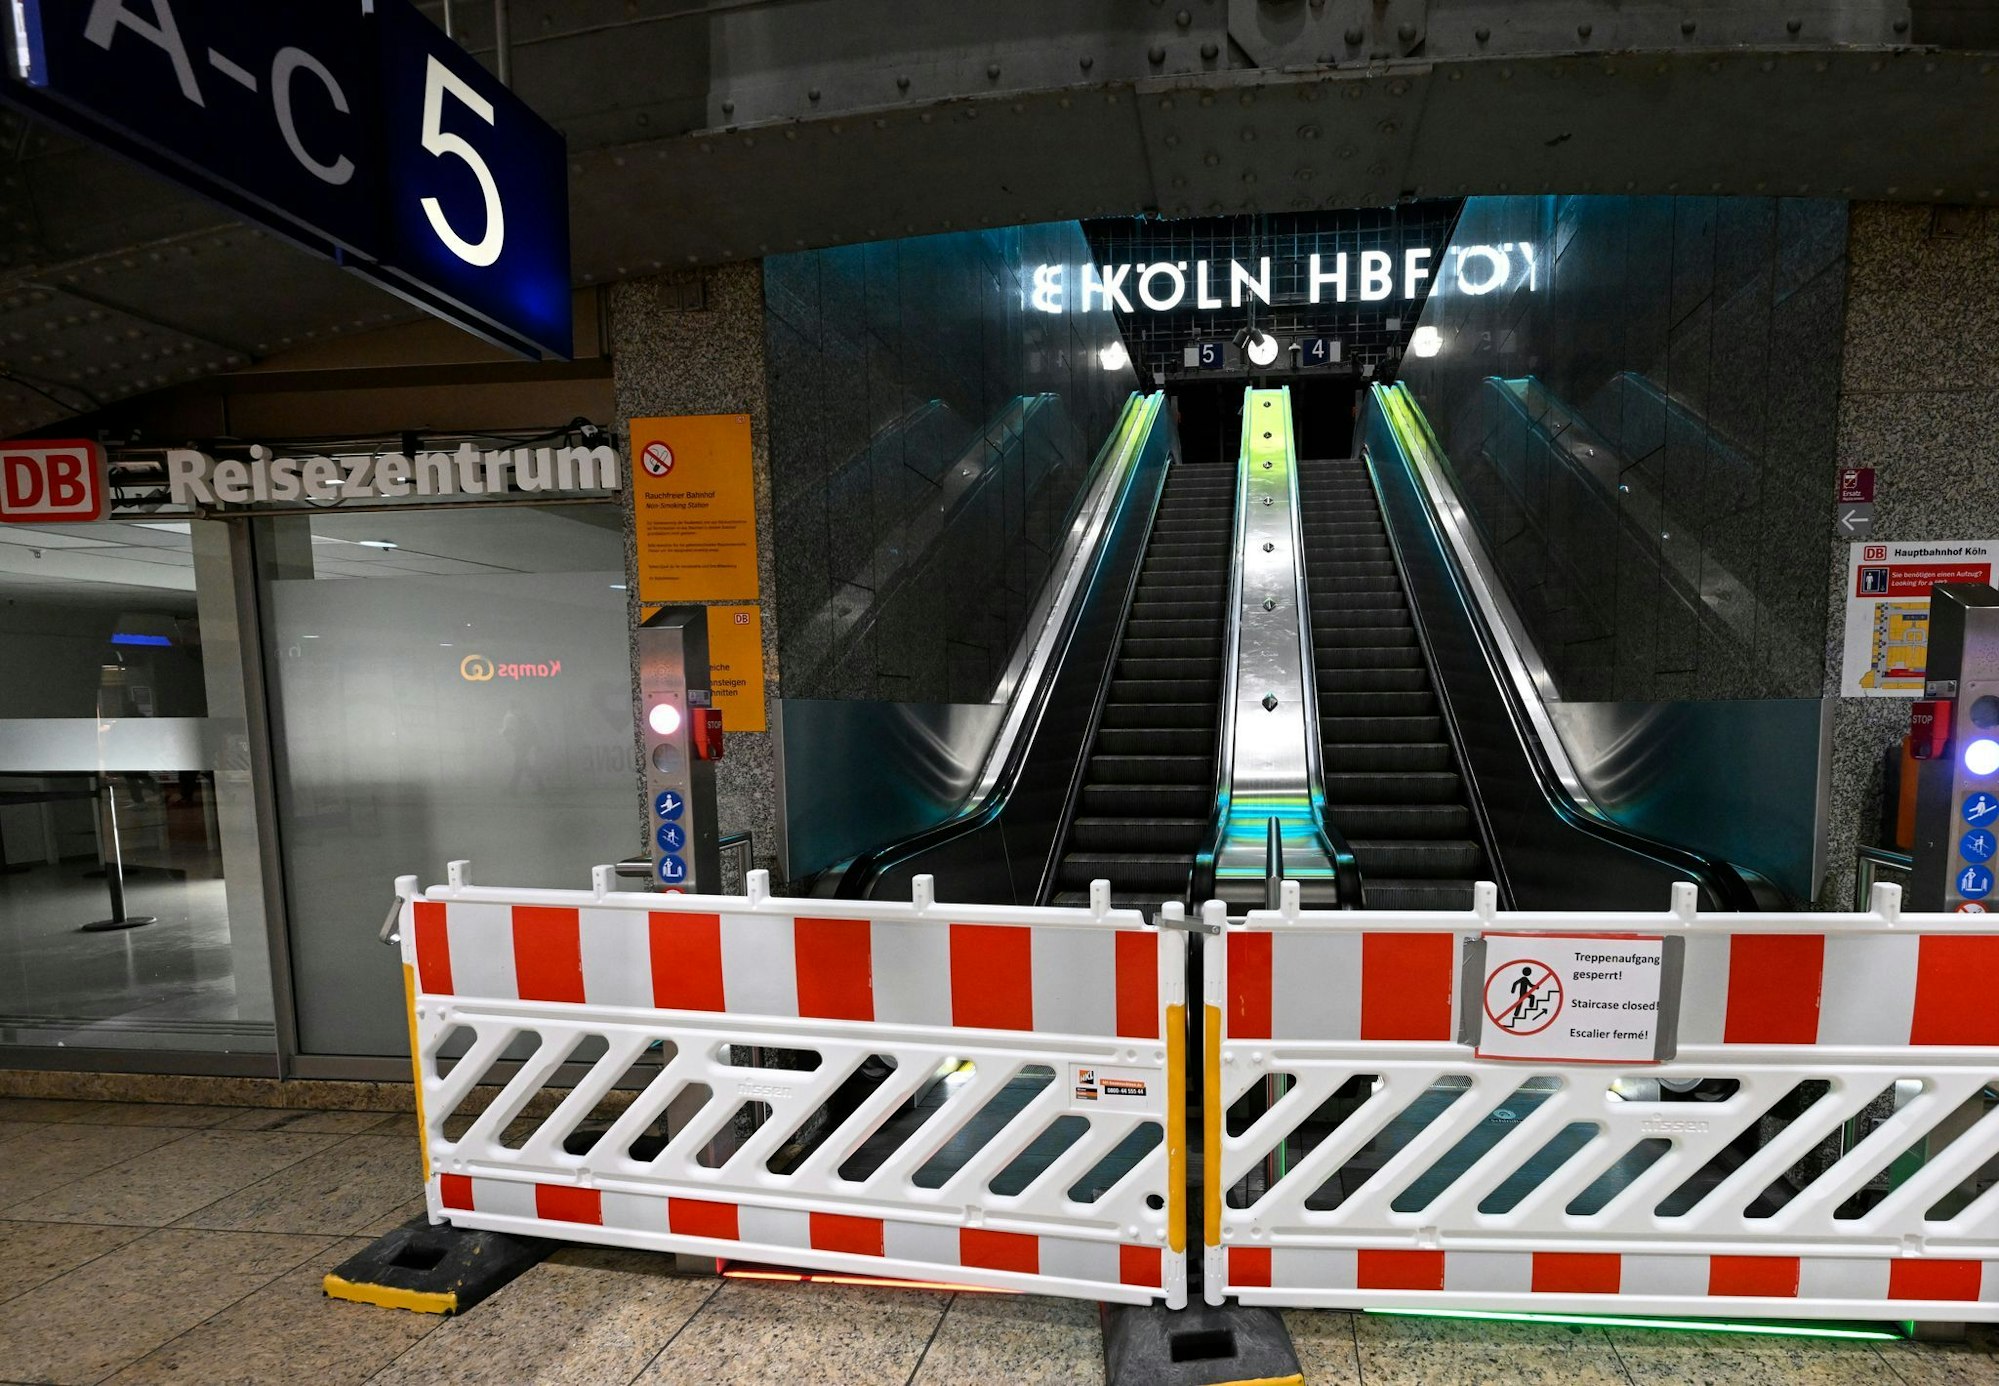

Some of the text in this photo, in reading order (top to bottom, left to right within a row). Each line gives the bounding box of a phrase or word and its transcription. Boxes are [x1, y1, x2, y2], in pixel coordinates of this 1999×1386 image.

[84, 0, 355, 186] A-C
[420, 53, 504, 267] 5
[1102, 247, 1432, 313] KÖLN HBF
[1202, 344, 1215, 363] 5
[1311, 339, 1325, 359] 4
[166, 443, 621, 505] Reisezentrum
[3, 454, 86, 509] DB
[645, 491, 716, 499] Rauchfreier Bahnhof
[645, 502, 686, 510] Non-Smoking
[1866, 548, 1884, 559] DB
[1894, 547, 1987, 558] Hauptbahnhof Köln
[736, 614, 748, 624] DB
[707, 720, 722, 730] STOP
[1912, 714, 1933, 725] STOP
[1574, 952, 1660, 966] Treppenaufgang
[1573, 970, 1622, 981] gesperrt!
[1571, 999, 1660, 1011] Staircase closed!
[1569, 1028, 1648, 1040] Escalier fermé!
[1641, 1112, 1709, 1133] nissen
